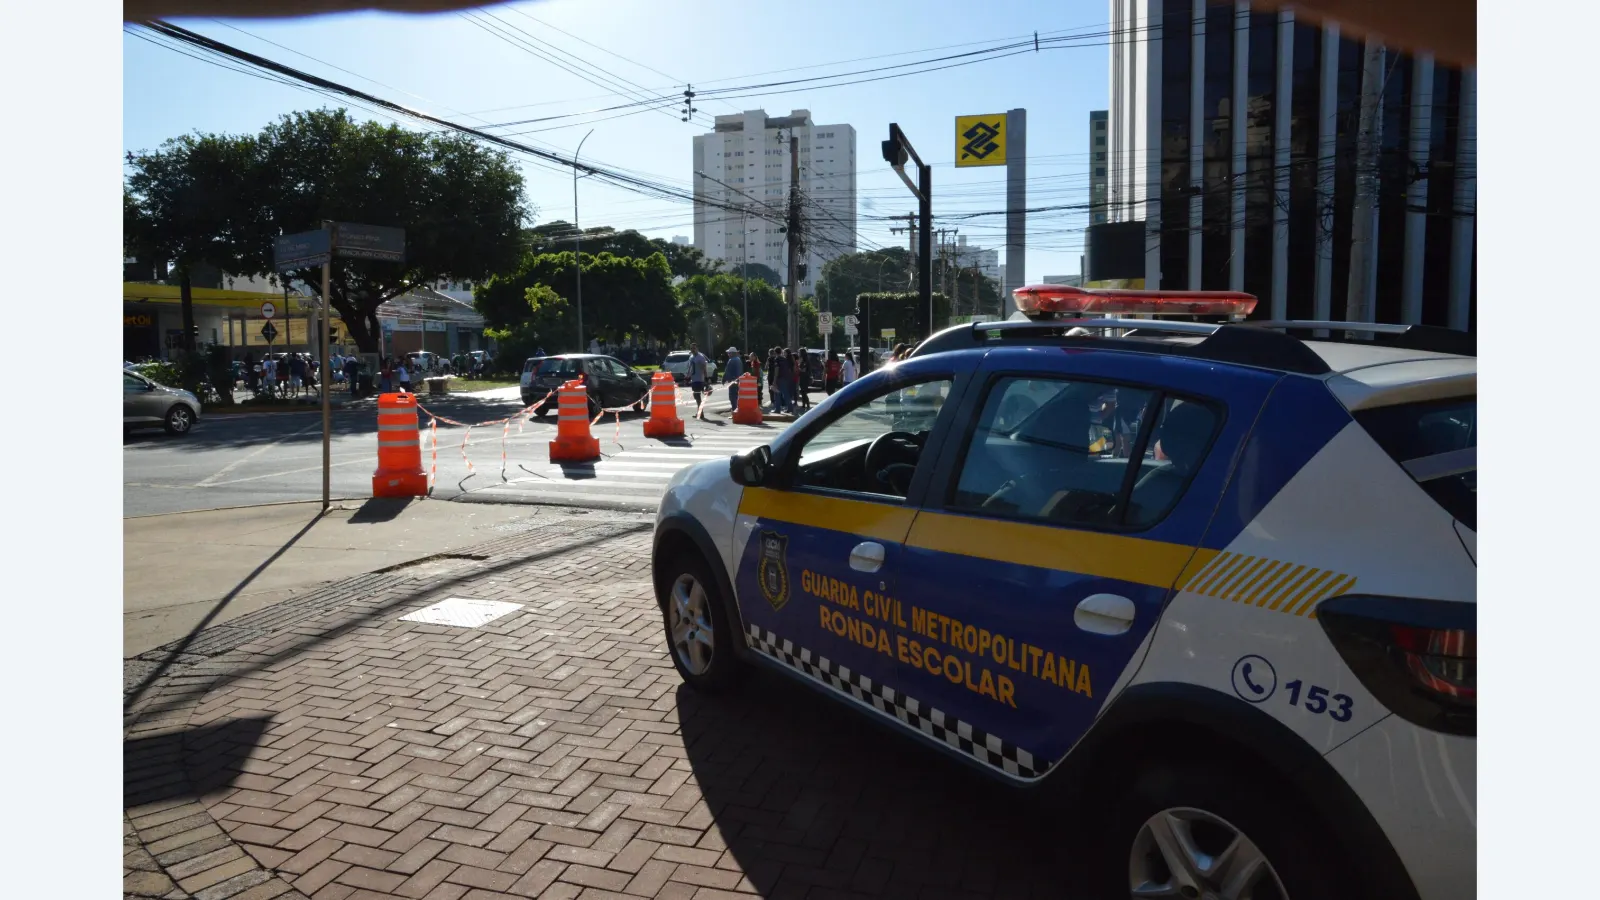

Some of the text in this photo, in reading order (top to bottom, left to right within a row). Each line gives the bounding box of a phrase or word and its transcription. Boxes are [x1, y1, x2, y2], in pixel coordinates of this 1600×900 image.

[801, 569, 1092, 698] GUARDA CIVIL METROPOLITANA
[819, 604, 1018, 709] RONDA ESCOLAR
[1284, 679, 1354, 723] 153
